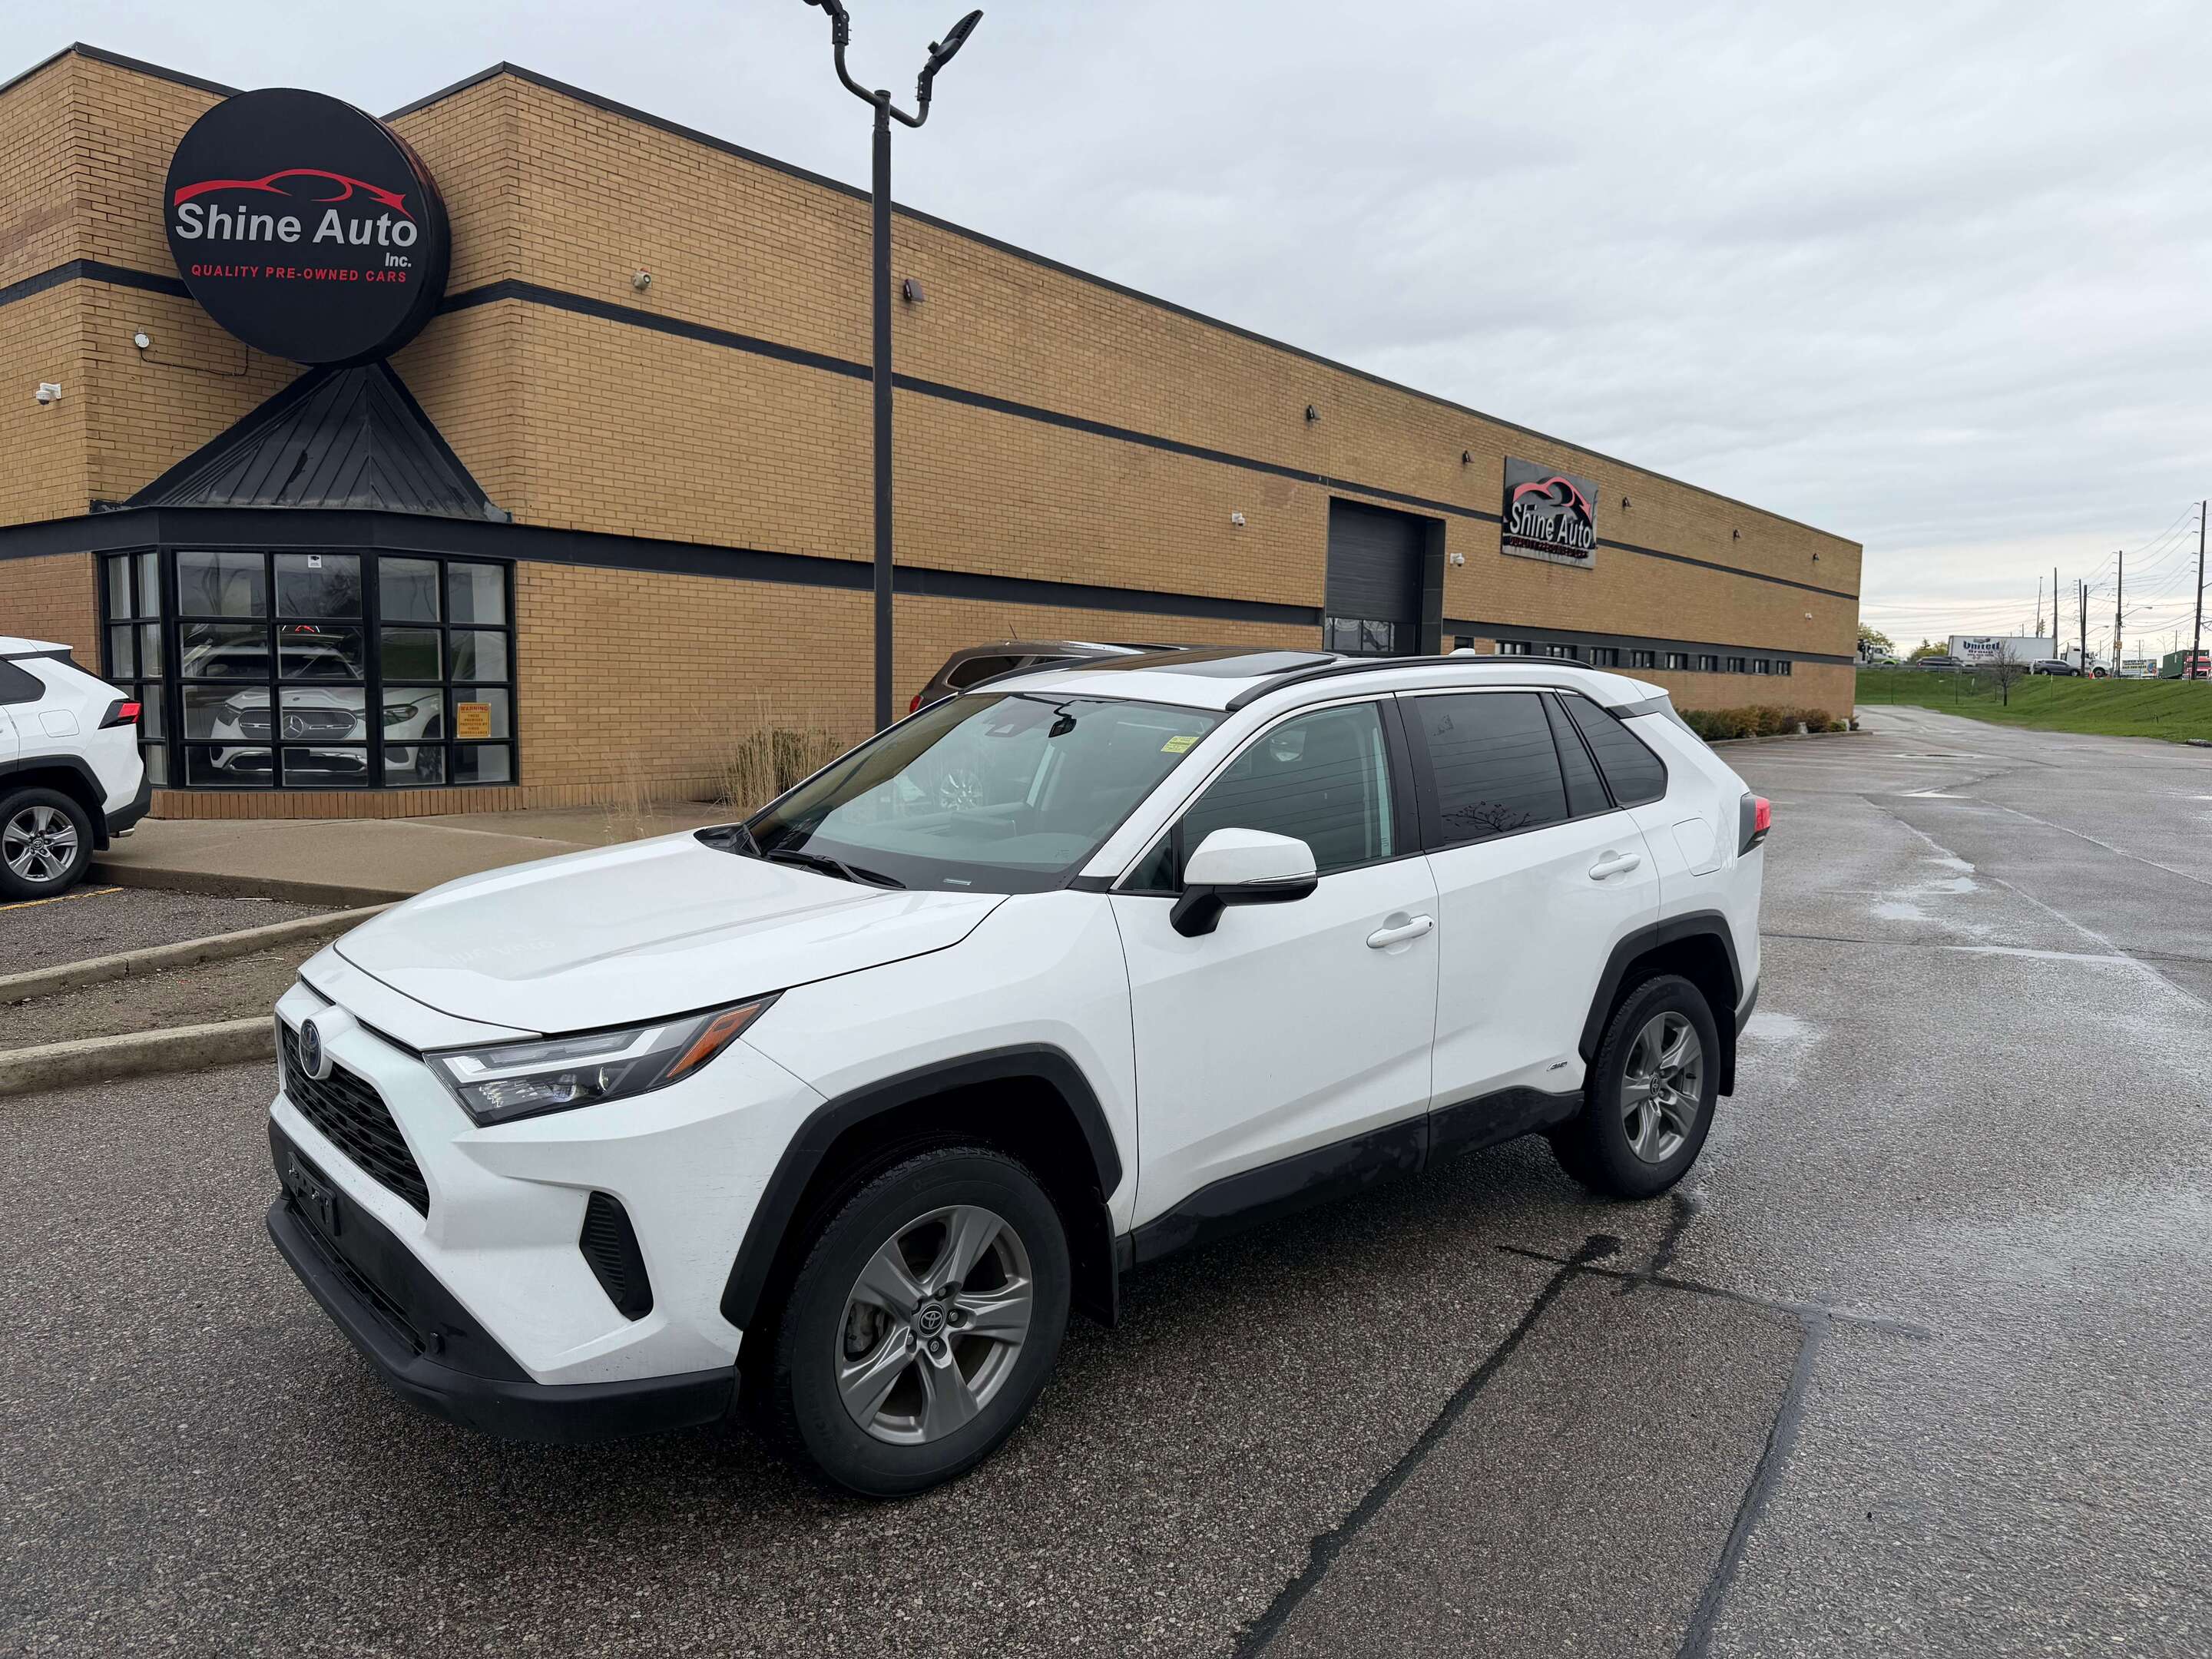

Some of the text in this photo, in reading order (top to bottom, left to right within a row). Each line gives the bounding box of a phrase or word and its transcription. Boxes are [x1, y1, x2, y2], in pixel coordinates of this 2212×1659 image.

[175, 203, 418, 247] Shine Auto
[385, 252, 412, 267] Inc.
[191, 263, 406, 283] QUALITY PRE-OWNED CARS
[1510, 502, 1555, 540] Shine
[1557, 515, 1591, 548] Auto
[1963, 641, 2000, 650] United
